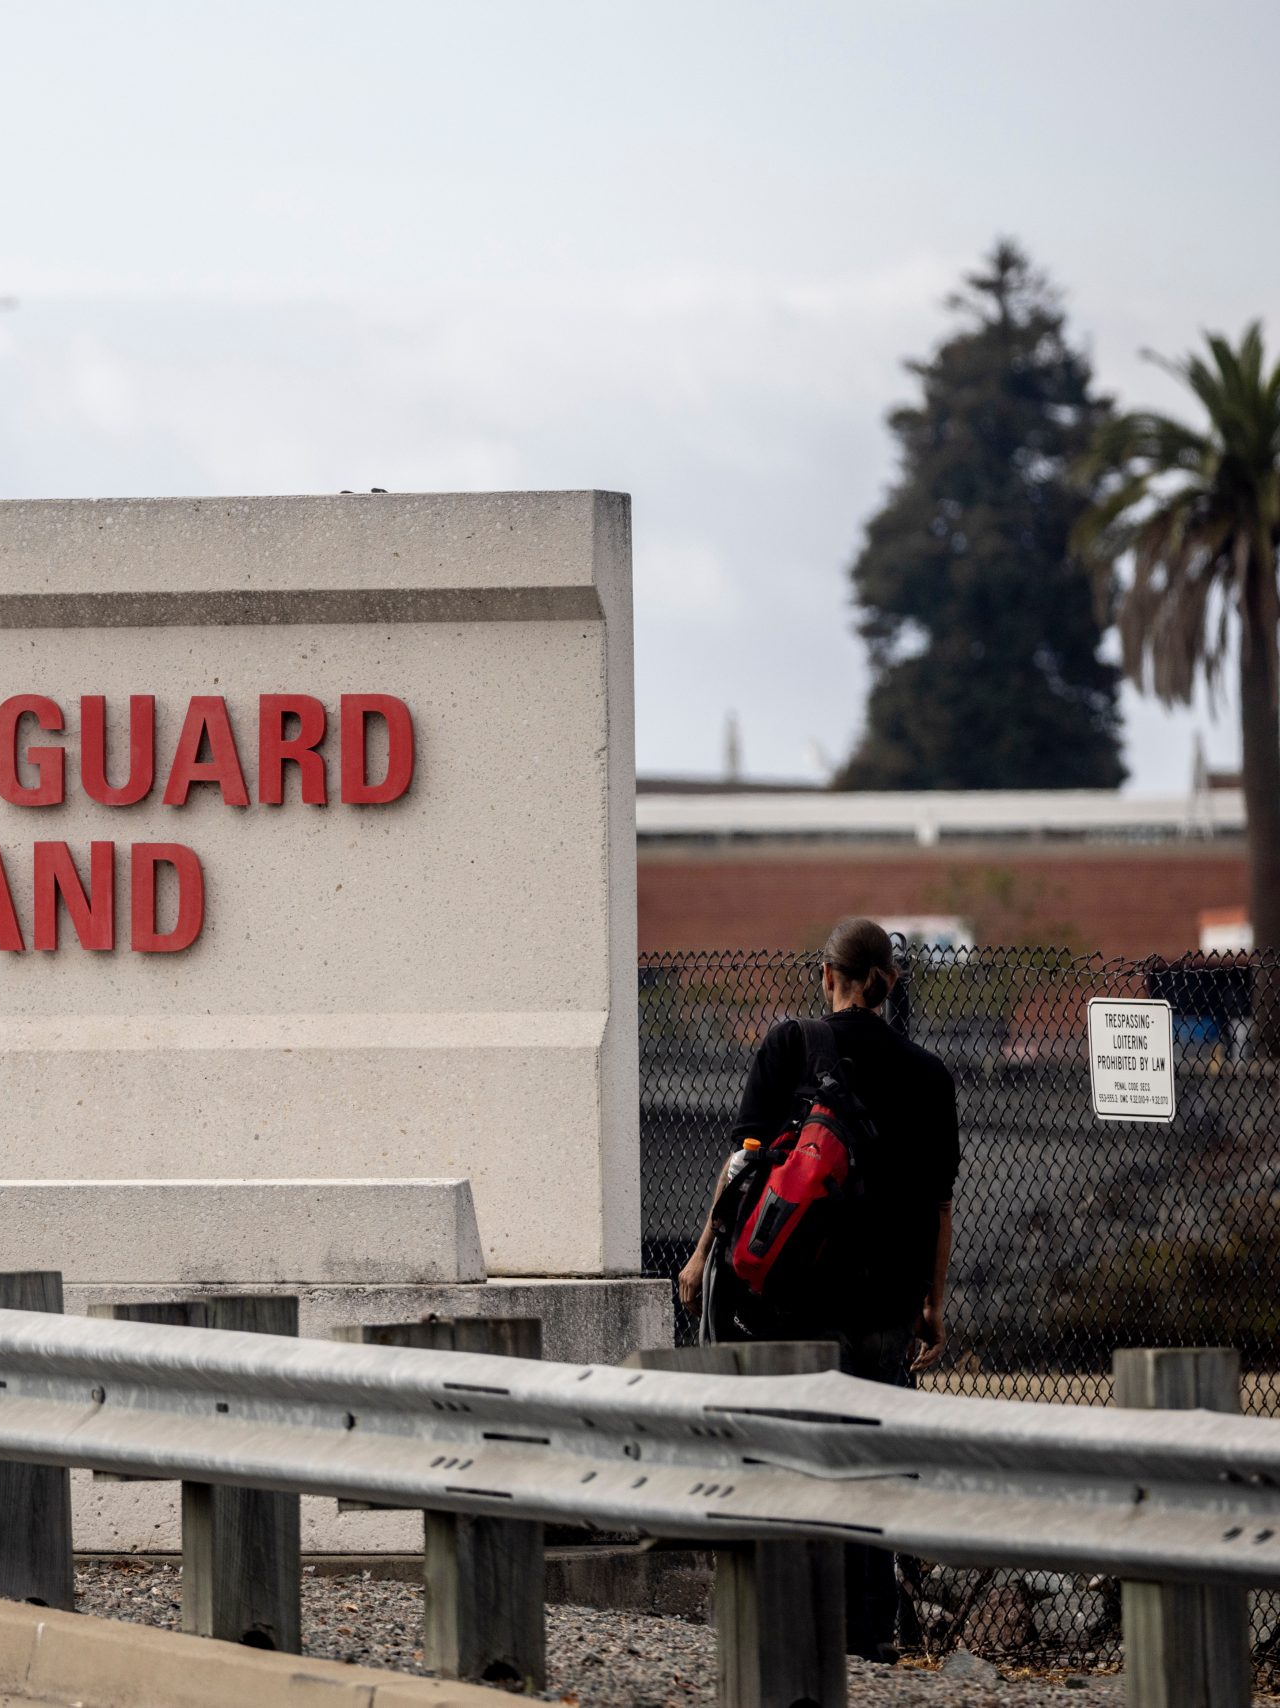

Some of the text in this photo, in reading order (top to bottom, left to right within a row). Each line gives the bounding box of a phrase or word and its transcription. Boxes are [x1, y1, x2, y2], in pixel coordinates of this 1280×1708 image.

[1113, 1035, 1148, 1050] LOITERING
[1097, 1055, 1166, 1071] PROHIBITED BY LAW
[1114, 1081, 1127, 1091] PENAL
[1128, 1082, 1139, 1091] CODE
